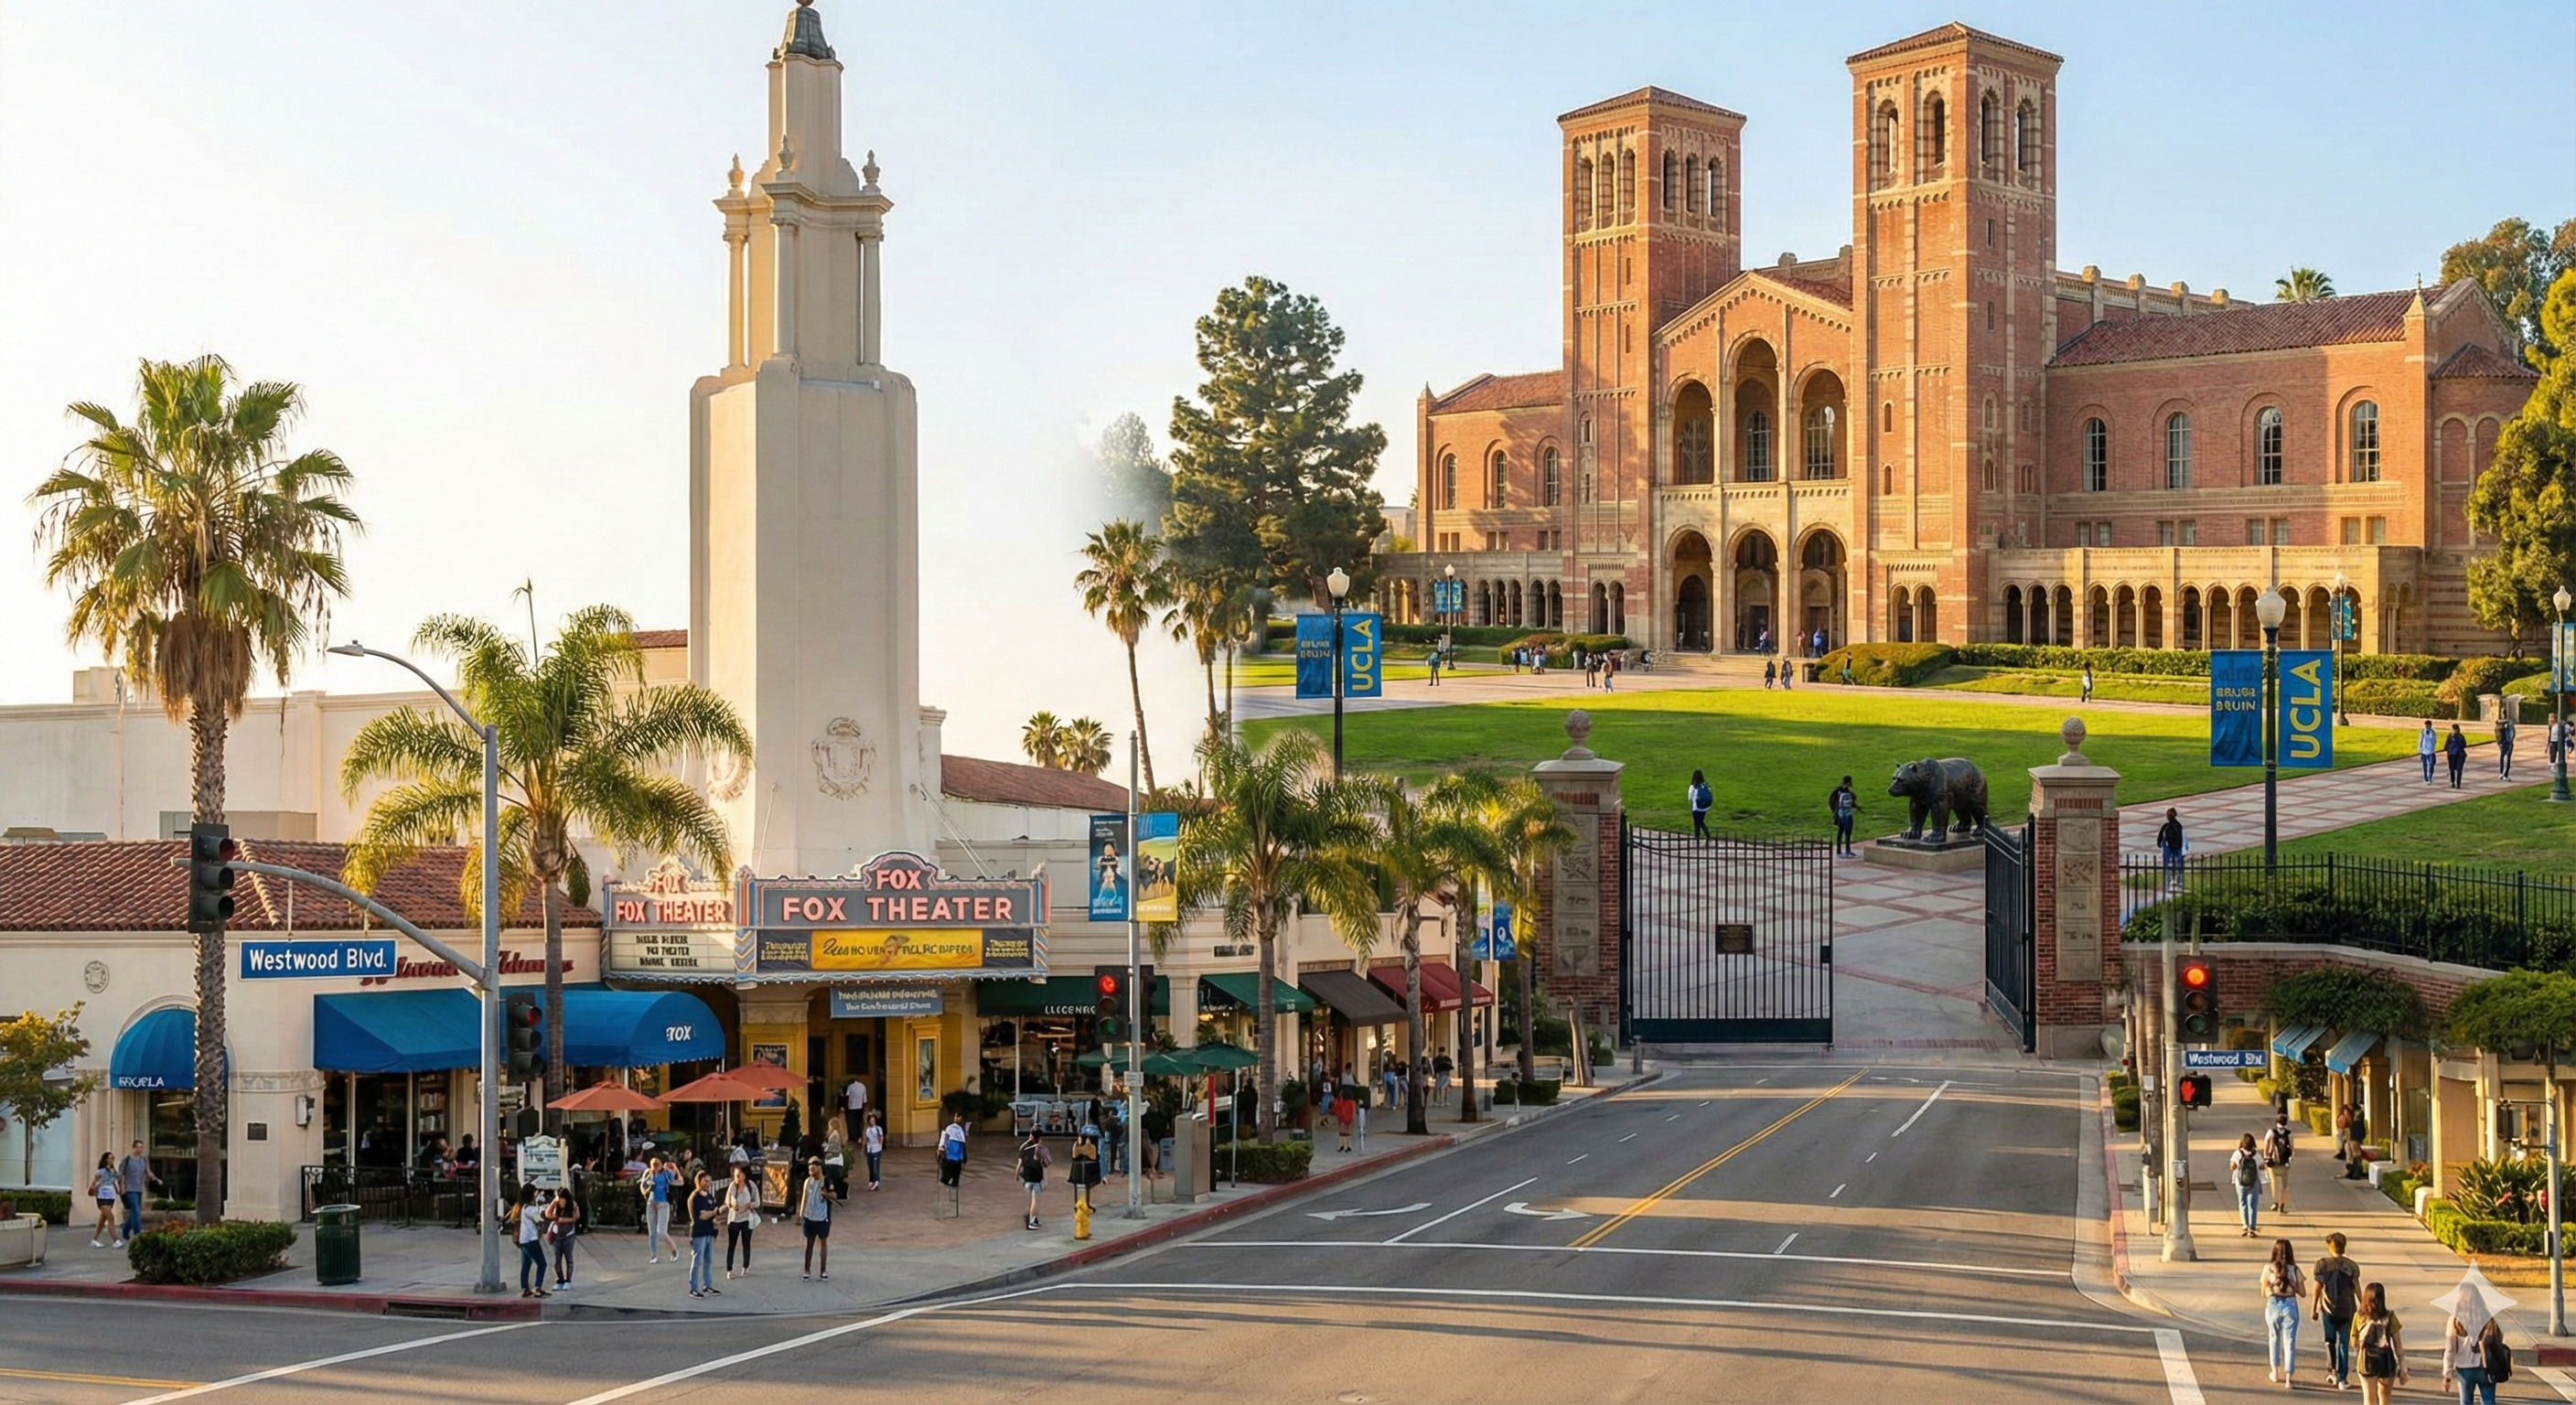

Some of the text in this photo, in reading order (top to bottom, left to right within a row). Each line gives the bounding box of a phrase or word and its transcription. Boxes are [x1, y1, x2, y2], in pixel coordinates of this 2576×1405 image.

[1350, 618, 1374, 691] UCLA
[2290, 659, 2322, 758] UCLA
[875, 869, 922, 890] FOX
[615, 900, 726, 922] FOX THEATER
[782, 897, 1013, 922] FOX THEATER
[249, 949, 338, 971] Westwood
[347, 948, 387, 968] Blvd.
